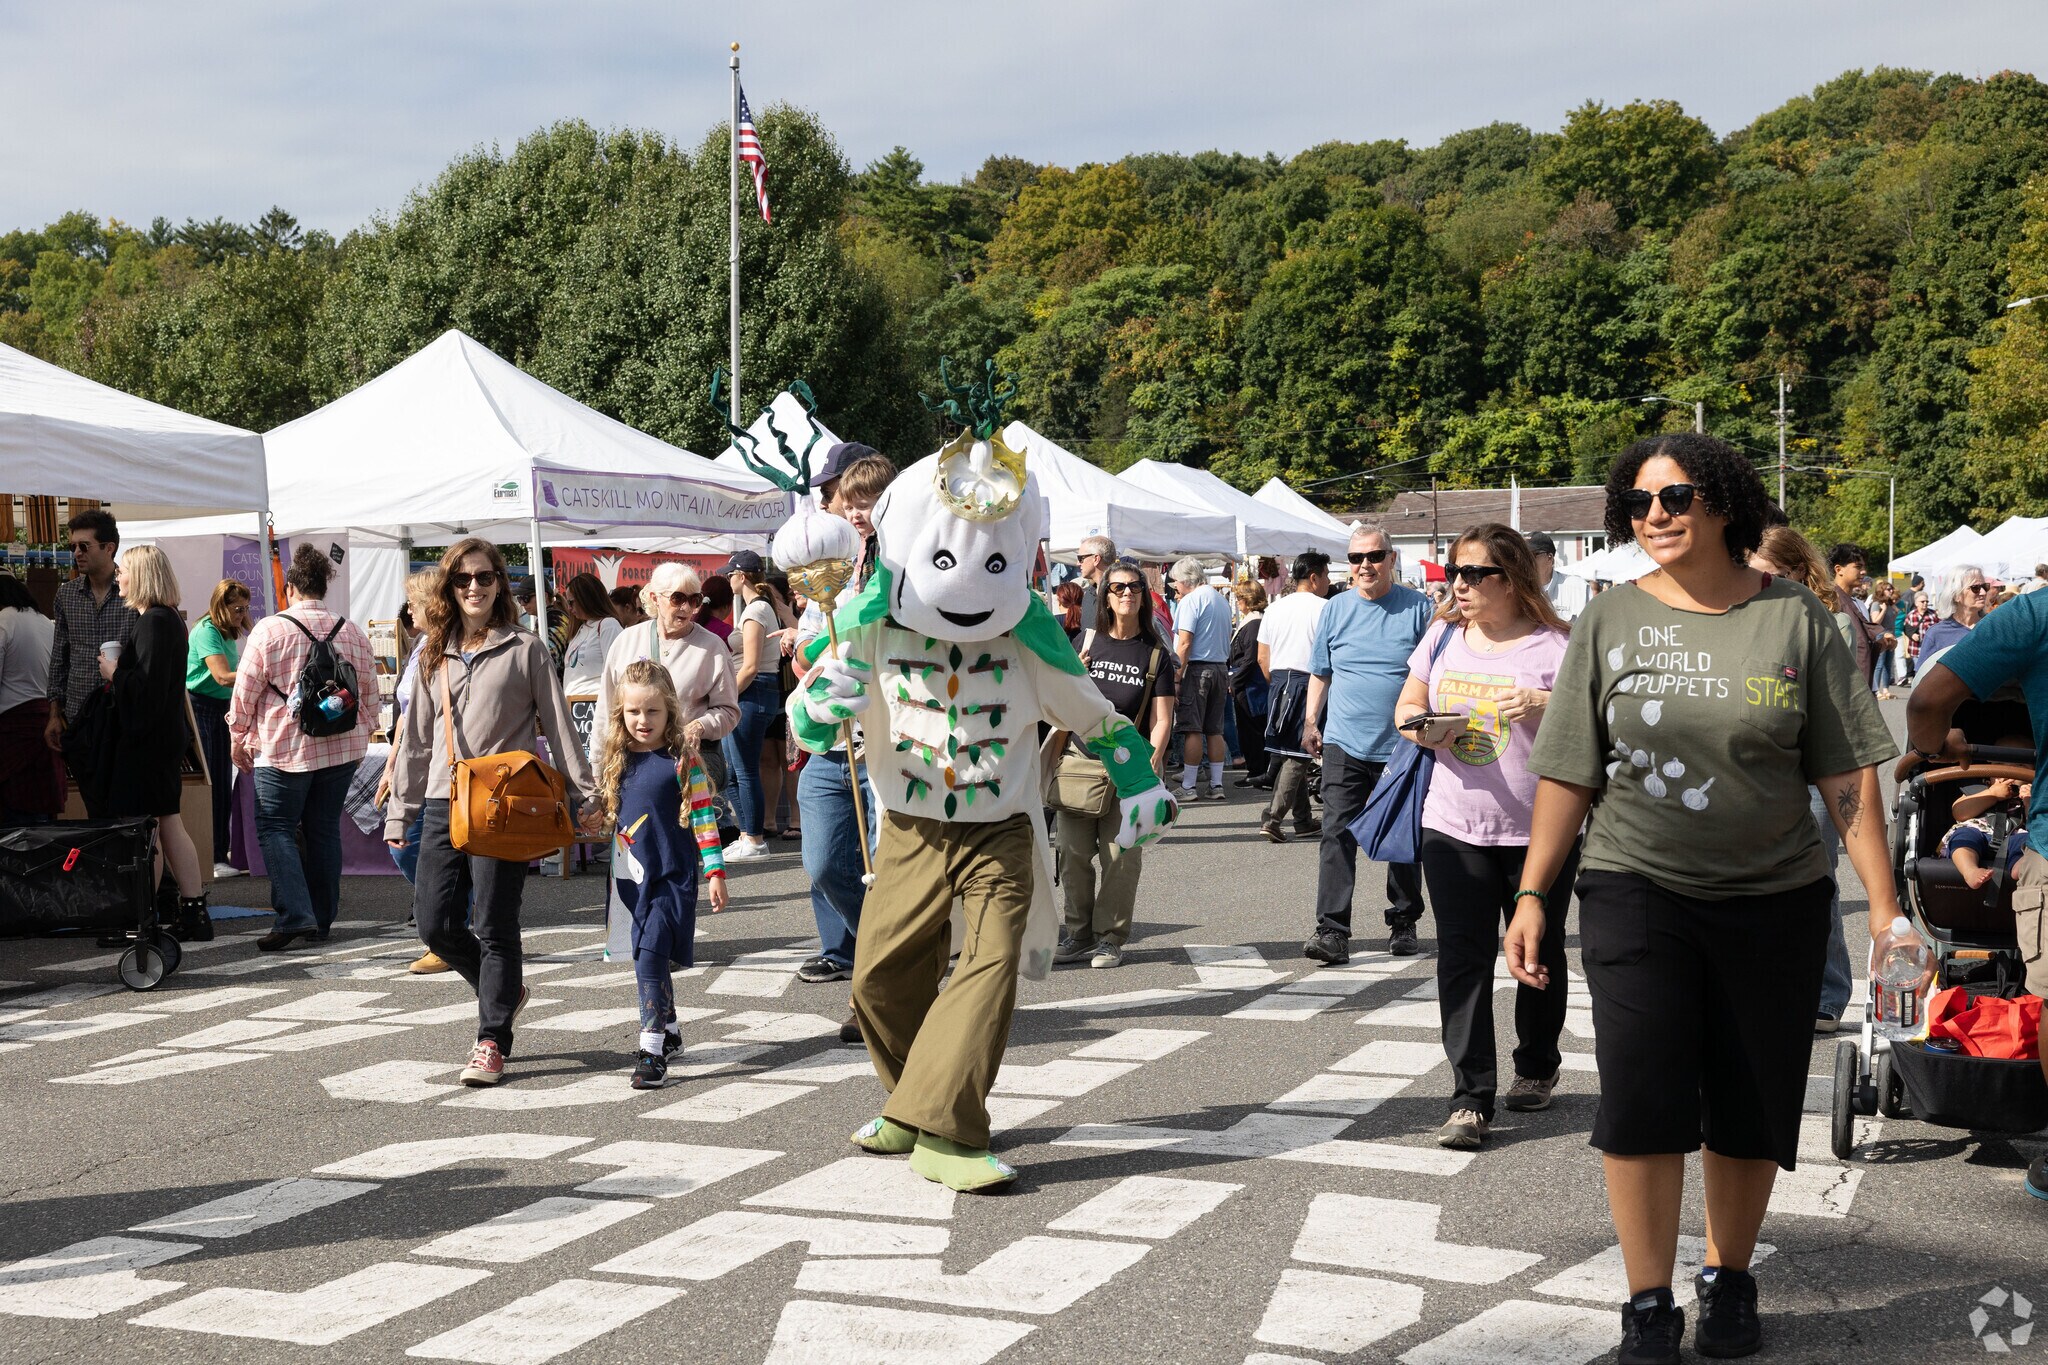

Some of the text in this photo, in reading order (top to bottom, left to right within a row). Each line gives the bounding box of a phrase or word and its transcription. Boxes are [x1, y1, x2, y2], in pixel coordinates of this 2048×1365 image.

[562, 487, 632, 509] CATSKILL
[718, 500, 787, 519] LAVENDER
[622, 567, 653, 580] PORCE
[1638, 624, 1684, 648] ONE
[1125, 664, 1140, 675] TO
[1635, 651, 1711, 672] WORLD
[1089, 669, 1144, 687] OB DYLAN
[1633, 673, 1730, 698] PUPPETS
[1440, 680, 1482, 697] FARM
